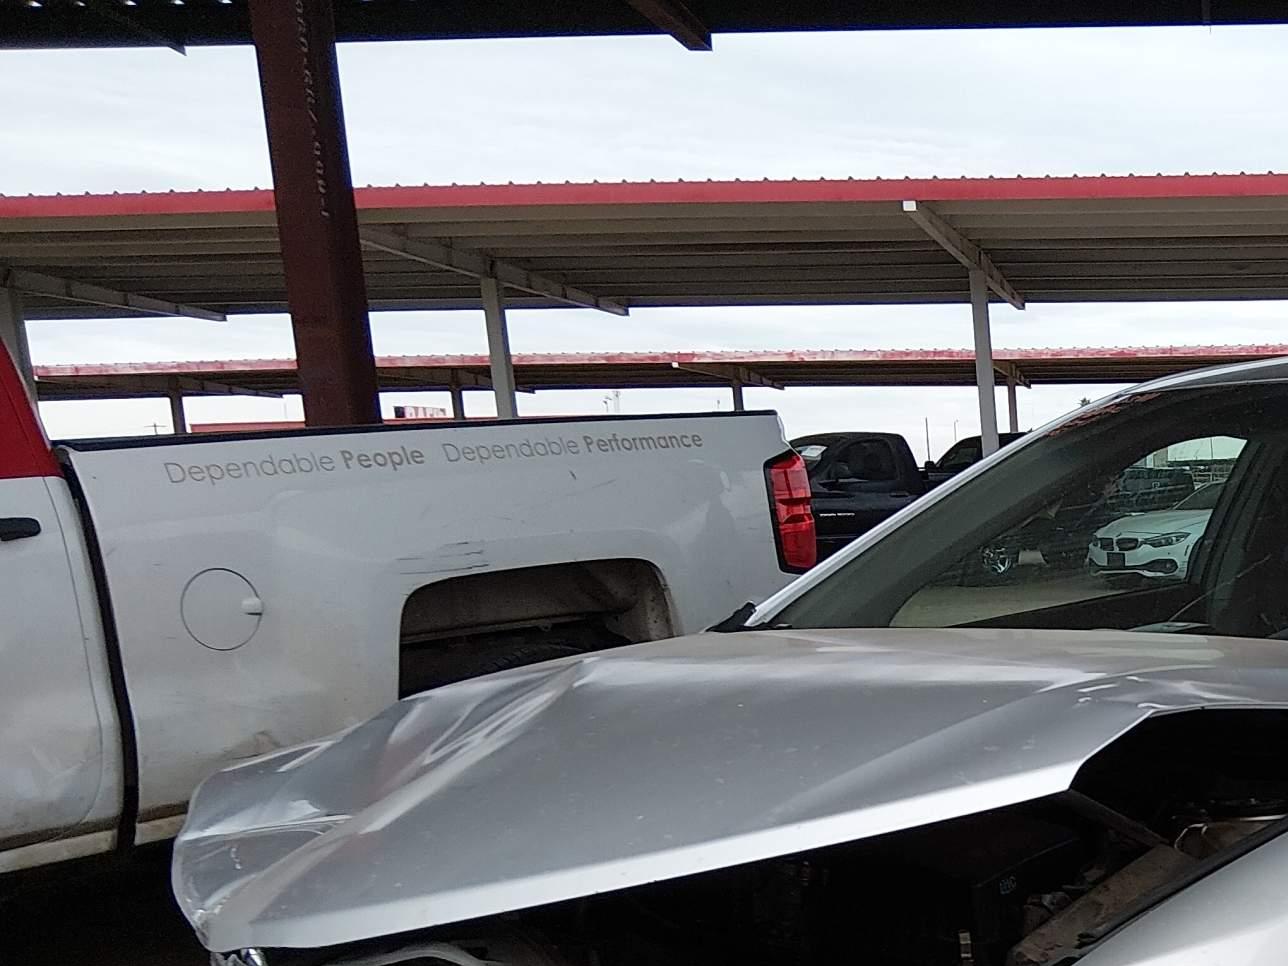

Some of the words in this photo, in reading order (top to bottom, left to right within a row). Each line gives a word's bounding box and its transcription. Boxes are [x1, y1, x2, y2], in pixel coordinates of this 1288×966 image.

[164, 453, 336, 486] Dependable
[339, 445, 426, 471] People
[441, 436, 581, 464] Dependable
[583, 431, 703, 453] Performance
